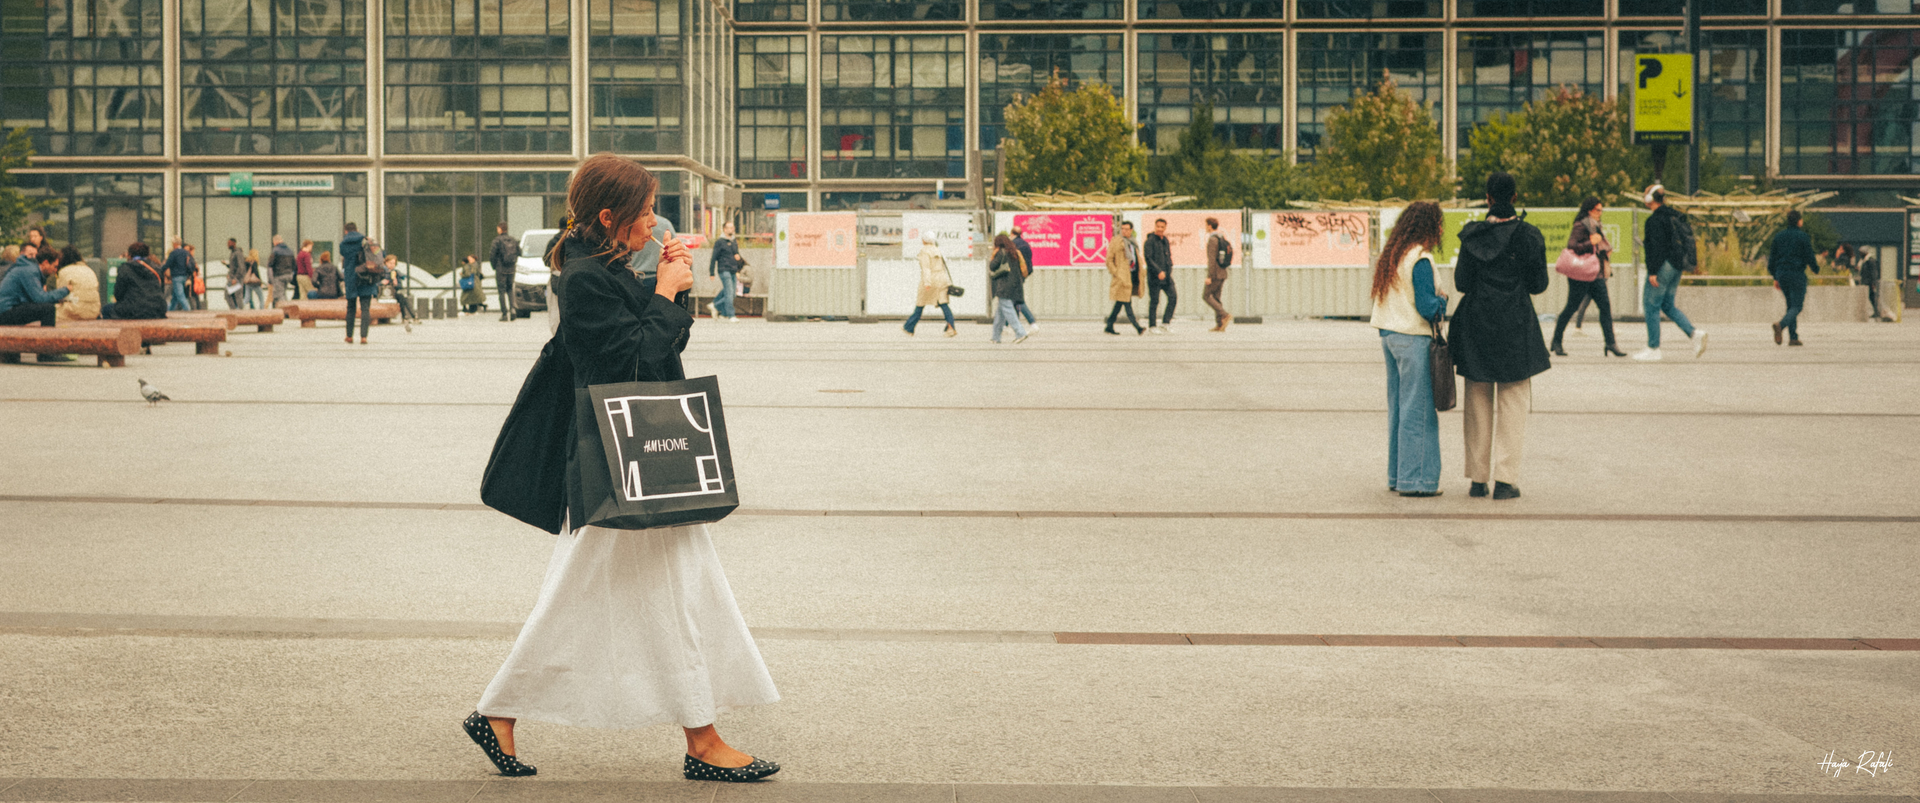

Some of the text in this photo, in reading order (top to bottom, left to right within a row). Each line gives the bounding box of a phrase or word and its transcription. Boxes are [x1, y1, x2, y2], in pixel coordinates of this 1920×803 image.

[1022, 231, 1062, 240] Suivez nos
[658, 437, 689, 452] HOME
